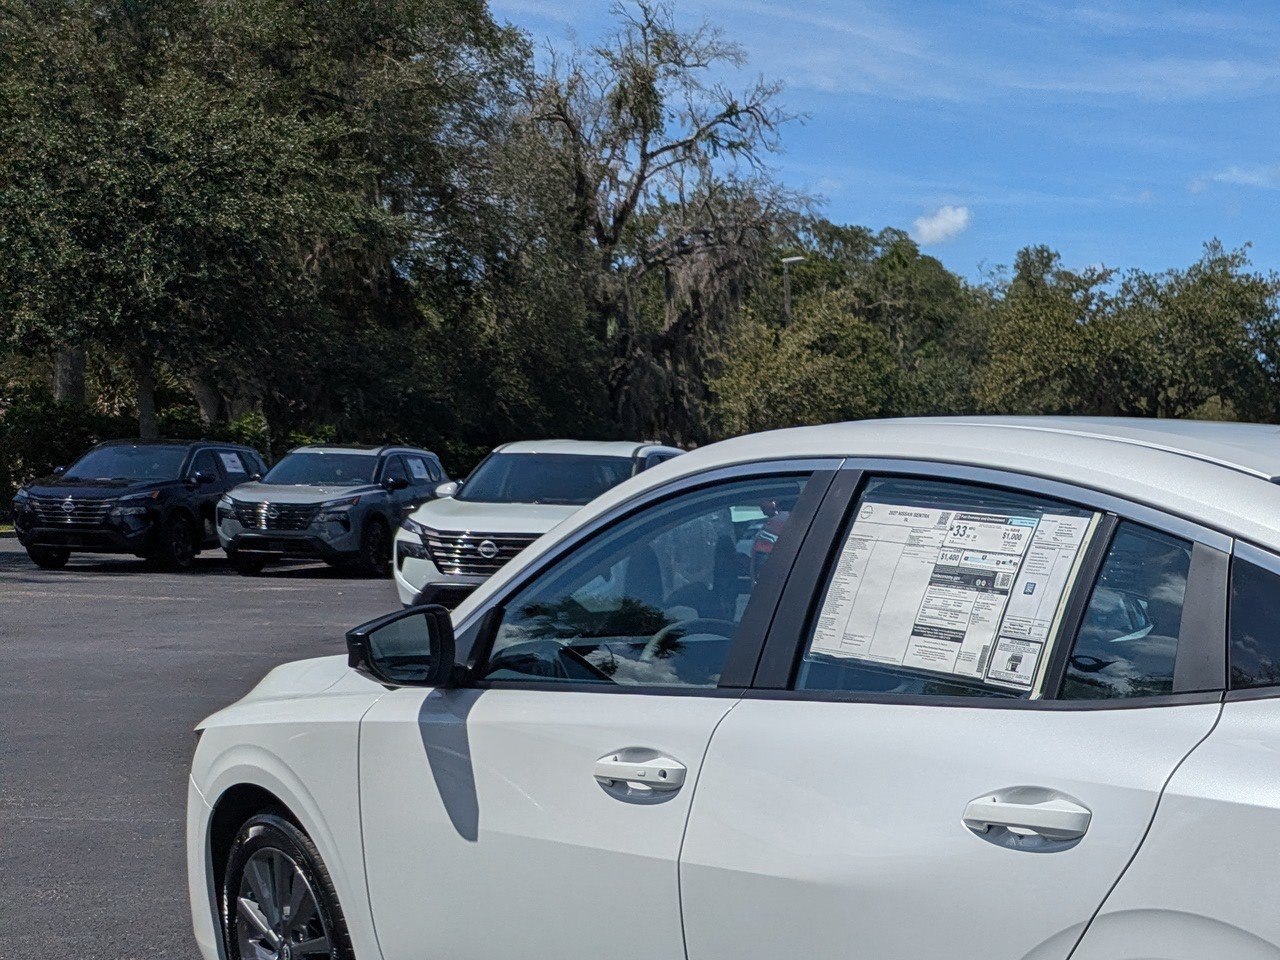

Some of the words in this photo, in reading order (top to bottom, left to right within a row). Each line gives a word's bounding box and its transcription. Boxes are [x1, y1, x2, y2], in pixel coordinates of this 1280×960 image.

[953, 525, 967, 537] 33
[1002, 532, 1022, 541] $1,000
[941, 552, 960, 562] $1,400
